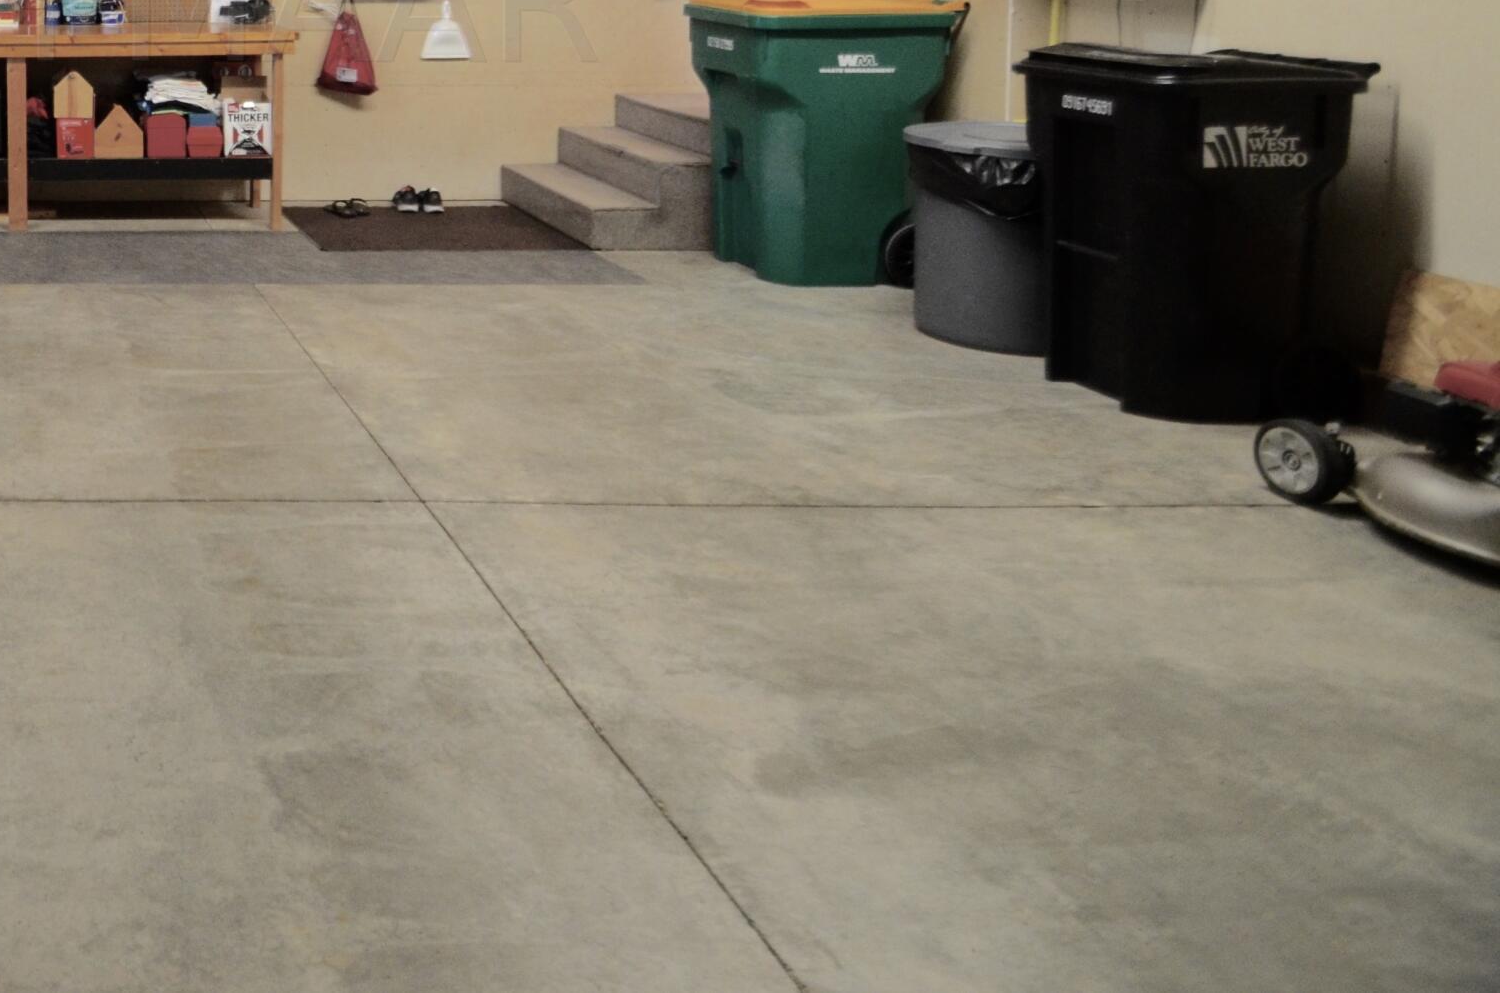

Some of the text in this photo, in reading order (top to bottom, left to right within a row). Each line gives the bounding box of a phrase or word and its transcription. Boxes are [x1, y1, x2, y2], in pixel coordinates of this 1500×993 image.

[228, 113, 269, 123] THICKER
[1248, 137, 1301, 152] WEST
[1249, 152, 1308, 168] FARGO
